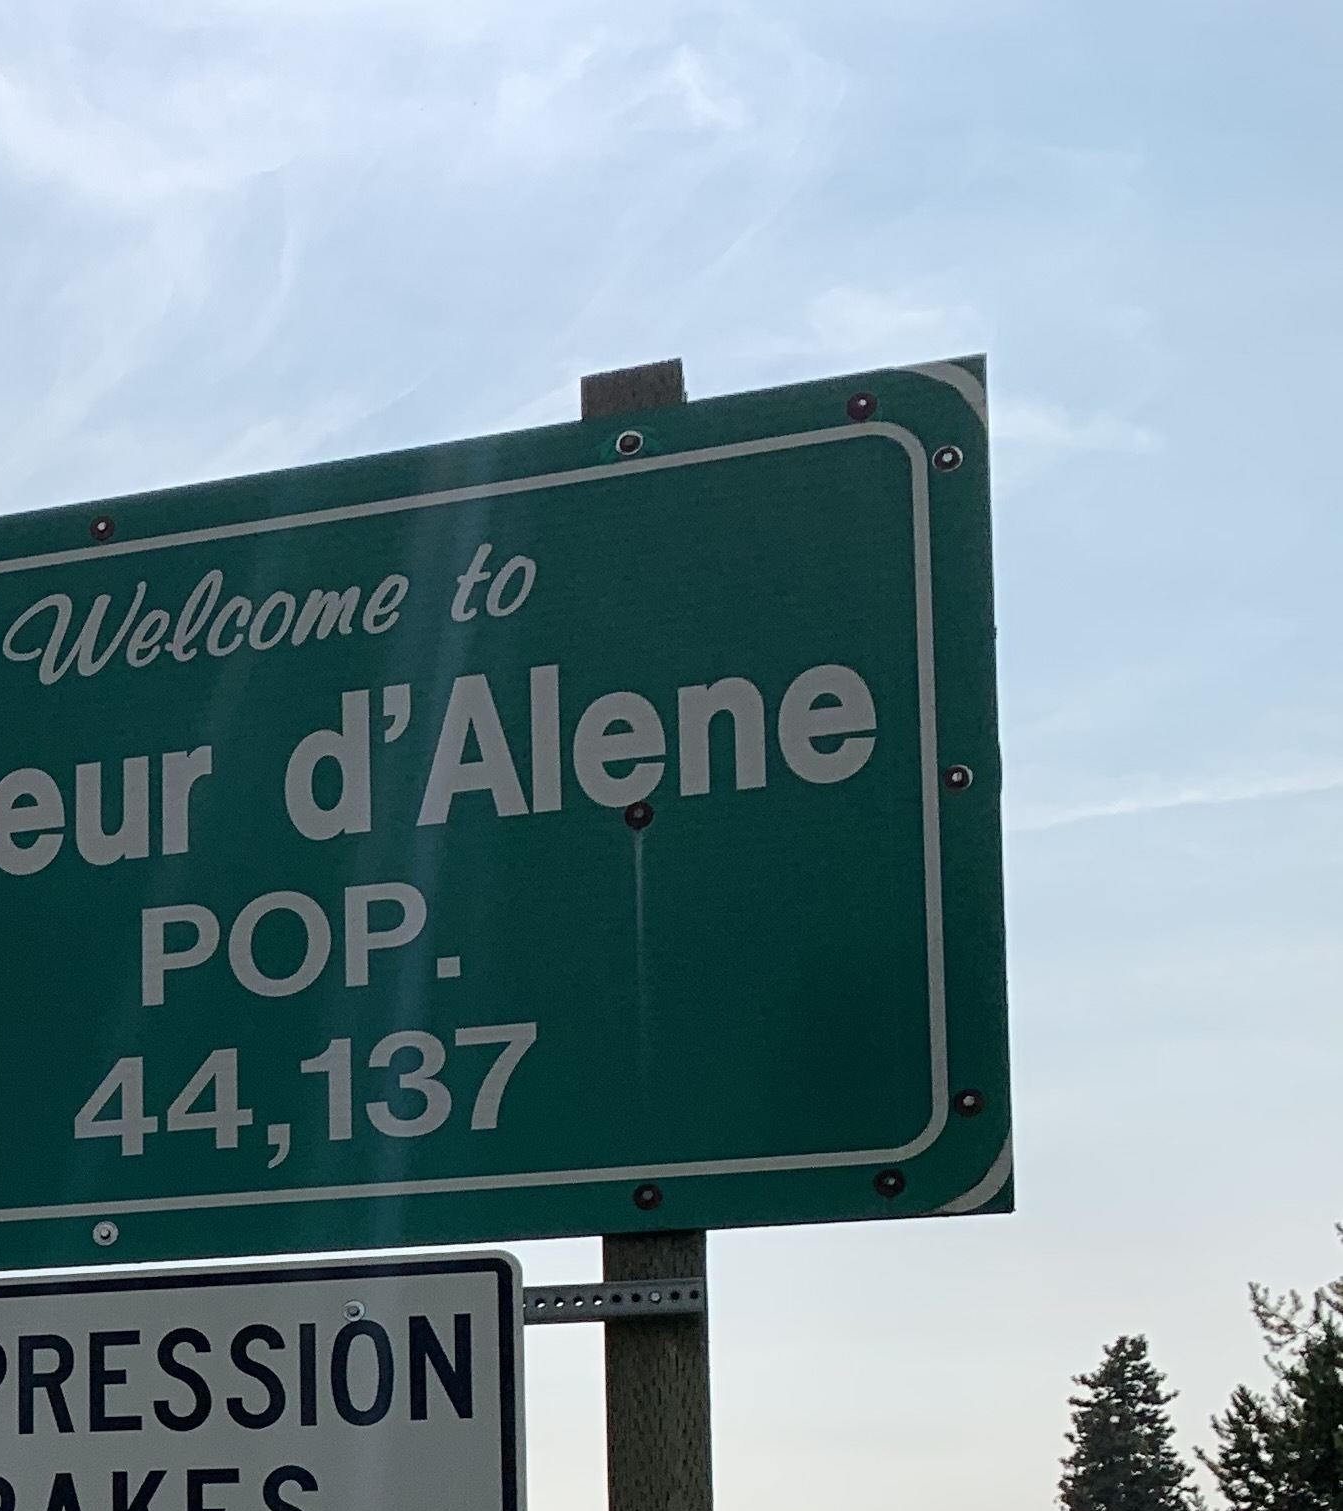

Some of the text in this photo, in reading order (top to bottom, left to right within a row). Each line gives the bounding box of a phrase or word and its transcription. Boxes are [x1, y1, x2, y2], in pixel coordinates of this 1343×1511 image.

[3, 544, 536, 684] Welcome to
[286, 665, 877, 839] d'Alene
[143, 883, 460, 1006] POP.
[76, 1023, 536, 1166] 44,137
